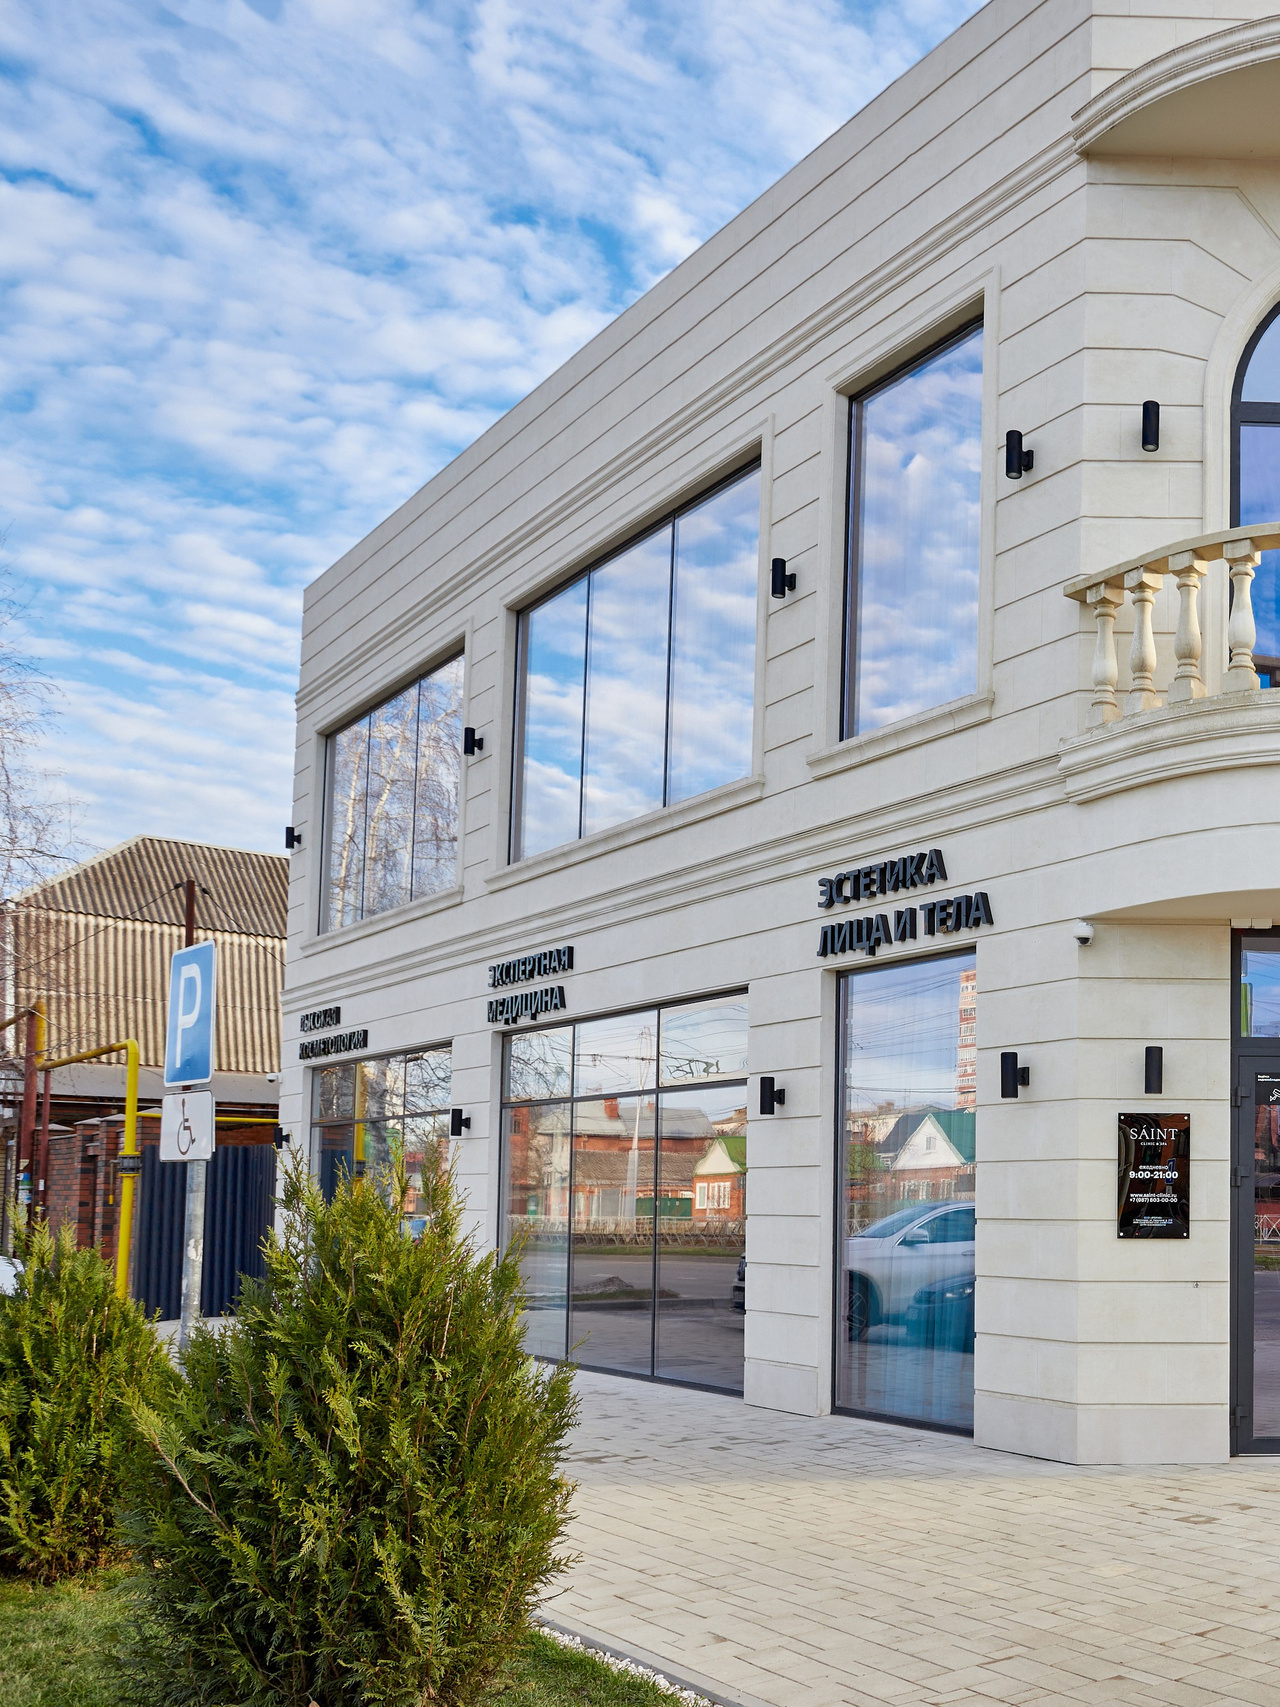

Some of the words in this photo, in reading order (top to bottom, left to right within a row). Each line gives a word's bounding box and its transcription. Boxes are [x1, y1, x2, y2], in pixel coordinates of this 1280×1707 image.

[818, 848, 948, 909] ЭСТЕТИКА
[816, 913, 893, 957] ЛИЦА
[894, 907, 917, 942] И
[919, 891, 994, 937] ТЕЛА
[488, 945, 574, 988] ЭКСПЕРТНАЯ
[175, 962, 202, 1069] P
[300, 1006, 341, 1032] ВЫСОКАЯ
[487, 985, 566, 1026] МЕДИЦИНА
[299, 1029, 368, 1060] КОСМЕТОЛОГИЯ
[1129, 1124, 1179, 1140] SÁINT
[1129, 1171, 1179, 1179] 9:00-21:00
